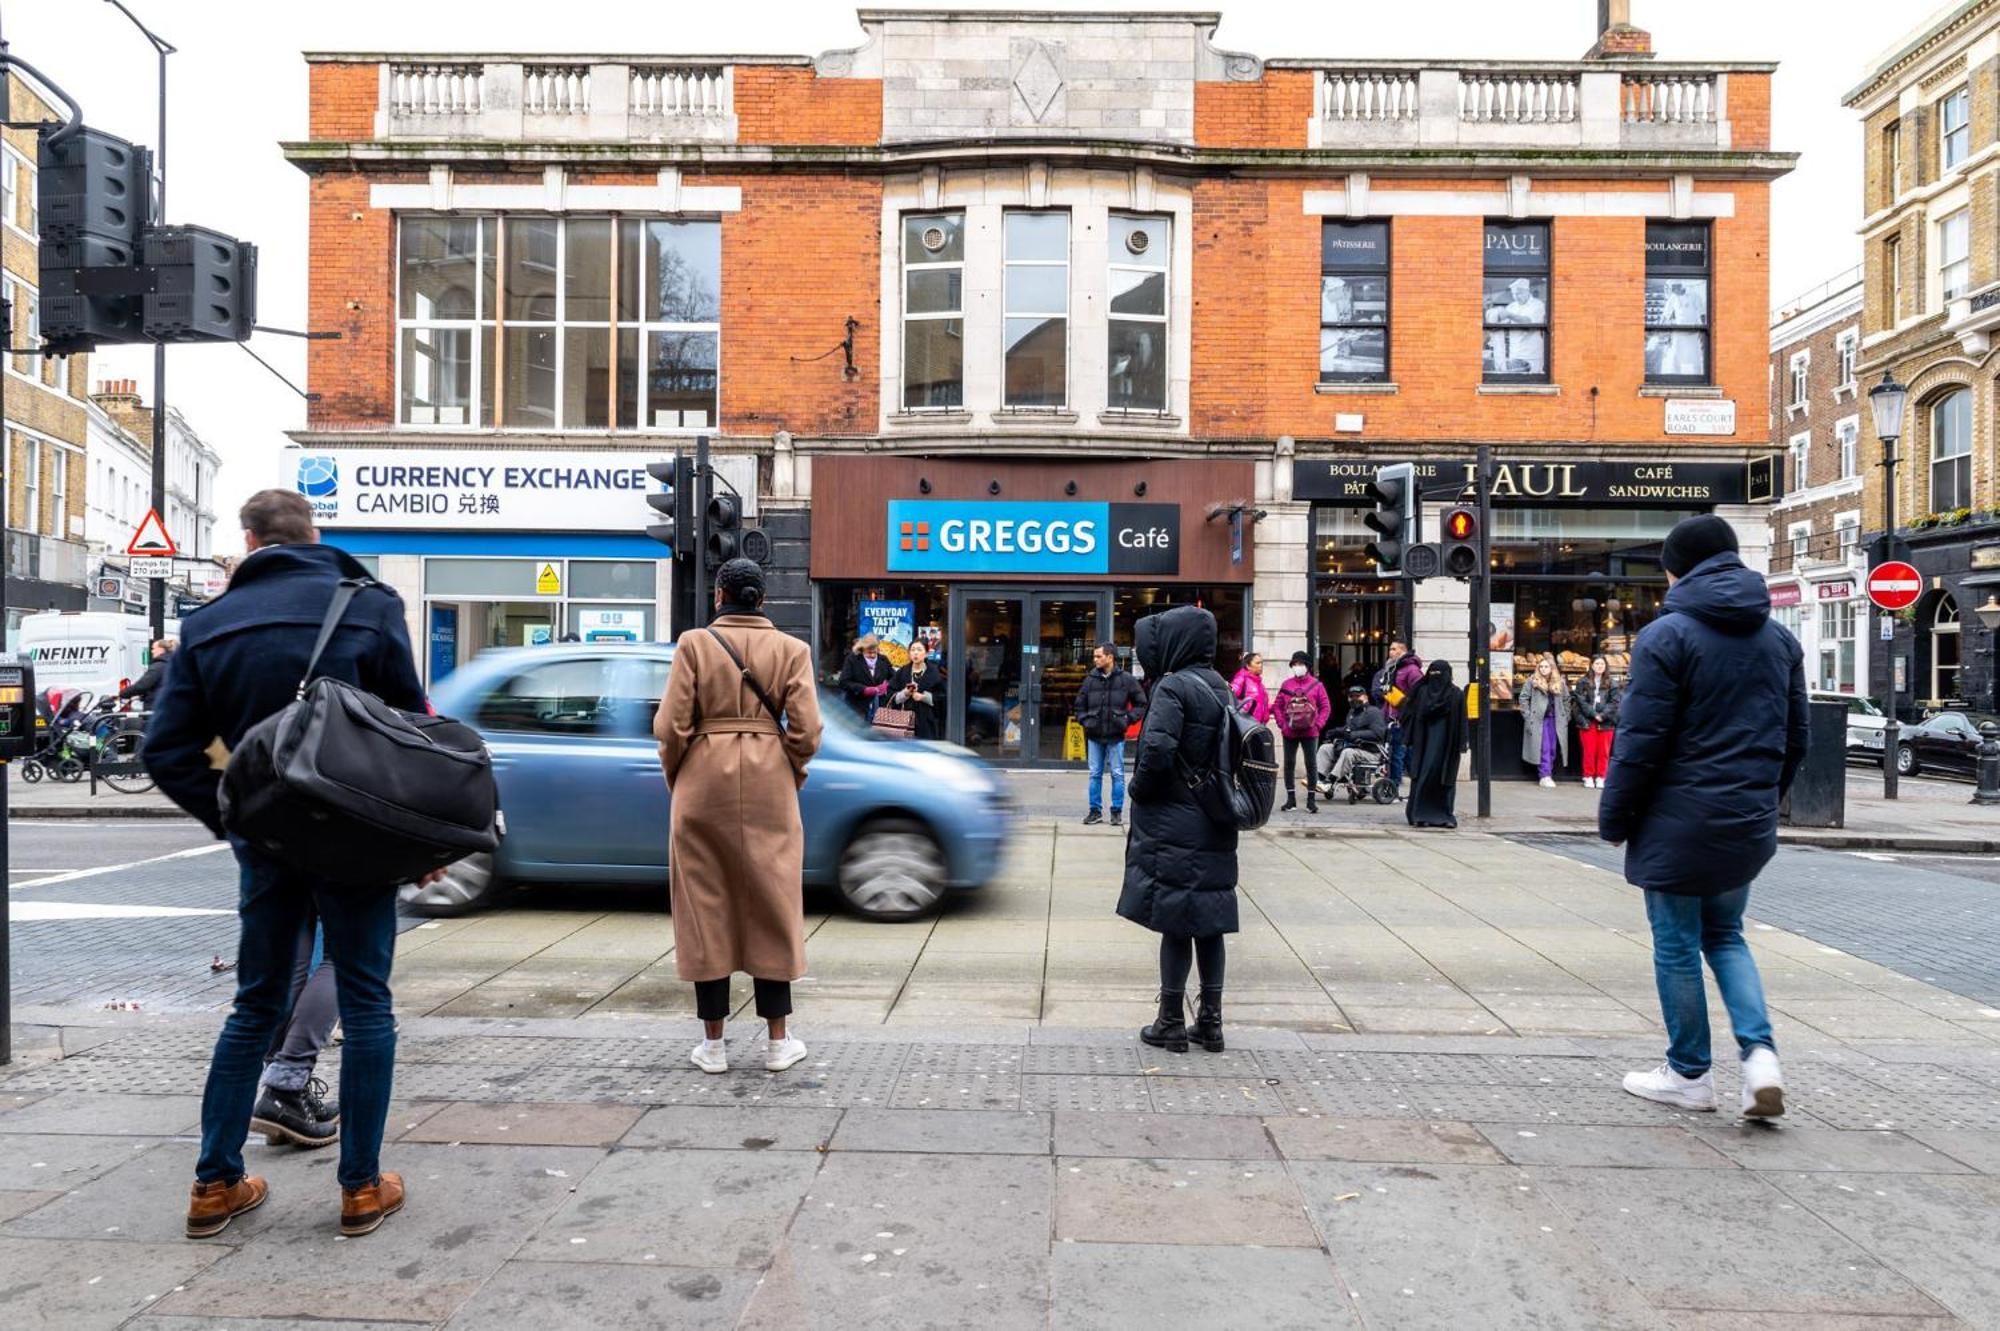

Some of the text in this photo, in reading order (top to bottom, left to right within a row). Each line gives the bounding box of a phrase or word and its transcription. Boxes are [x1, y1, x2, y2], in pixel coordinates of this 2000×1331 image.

[1332, 239, 1377, 249] PÂTISSERIE
[1485, 234, 1541, 249] PAUL
[1667, 414, 1732, 423] EARLS COURT
[1667, 424, 1696, 432] ROAD
[1330, 464, 1437, 477] BOULARIE
[1634, 466, 1673, 480] CAFÉ
[356, 466, 646, 490] CURRENCY EXCHANGE
[1608, 486, 1710, 498] SANDWICHES
[310, 501, 338, 510] obal
[356, 493, 449, 514] CAMBIO
[940, 519, 1169, 553] GREGGS Café
[150, 568, 169, 576] yards
[864, 607, 908, 617] EVERYDAY
[872, 617, 899, 626] TASTY
[31, 646, 110, 661] INFINITY
